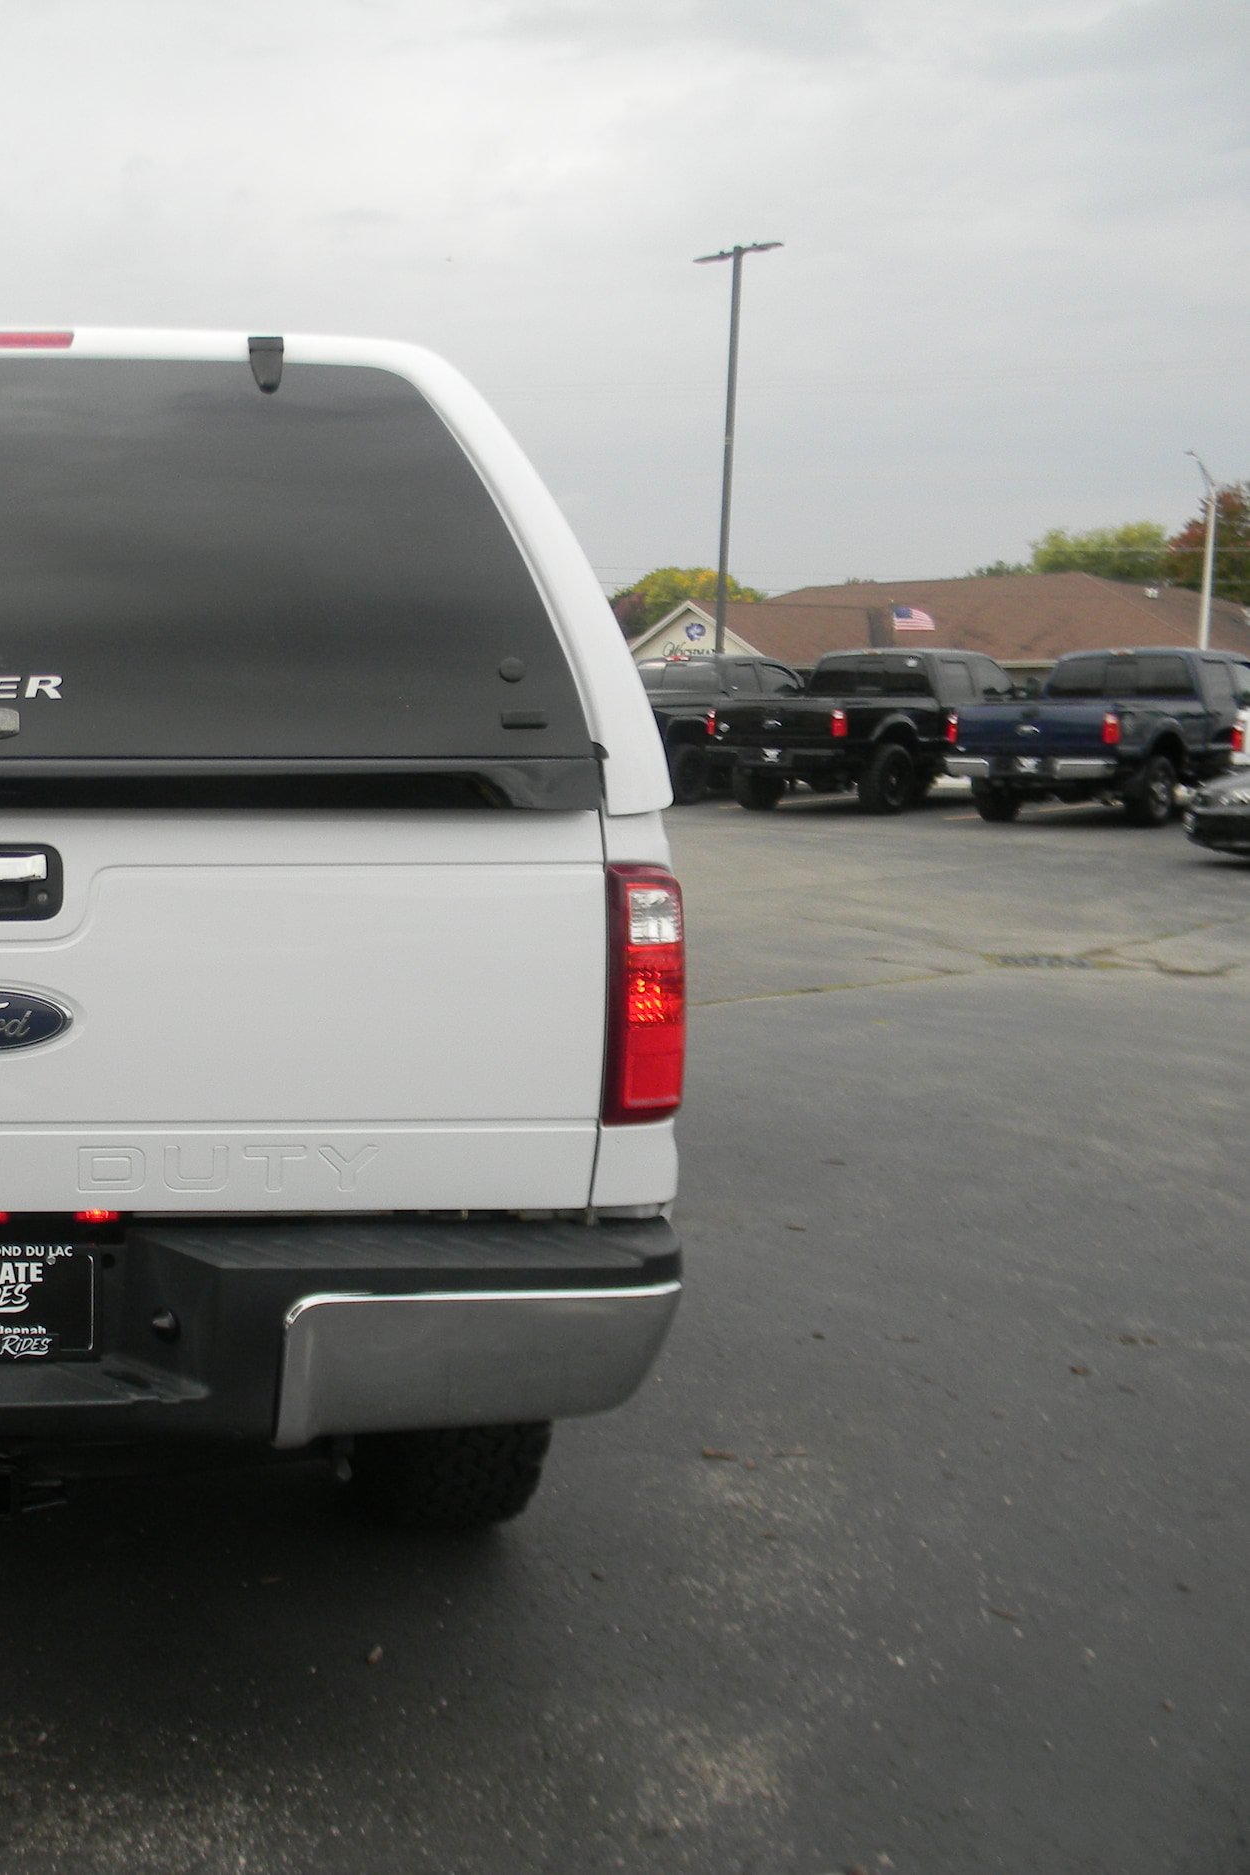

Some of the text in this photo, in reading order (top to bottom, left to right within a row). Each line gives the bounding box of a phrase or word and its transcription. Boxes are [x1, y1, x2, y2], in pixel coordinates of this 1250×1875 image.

[76, 1144, 380, 1193] DUTY
[26, 1246, 45, 1257] DU
[49, 1246, 73, 1257] LAC
